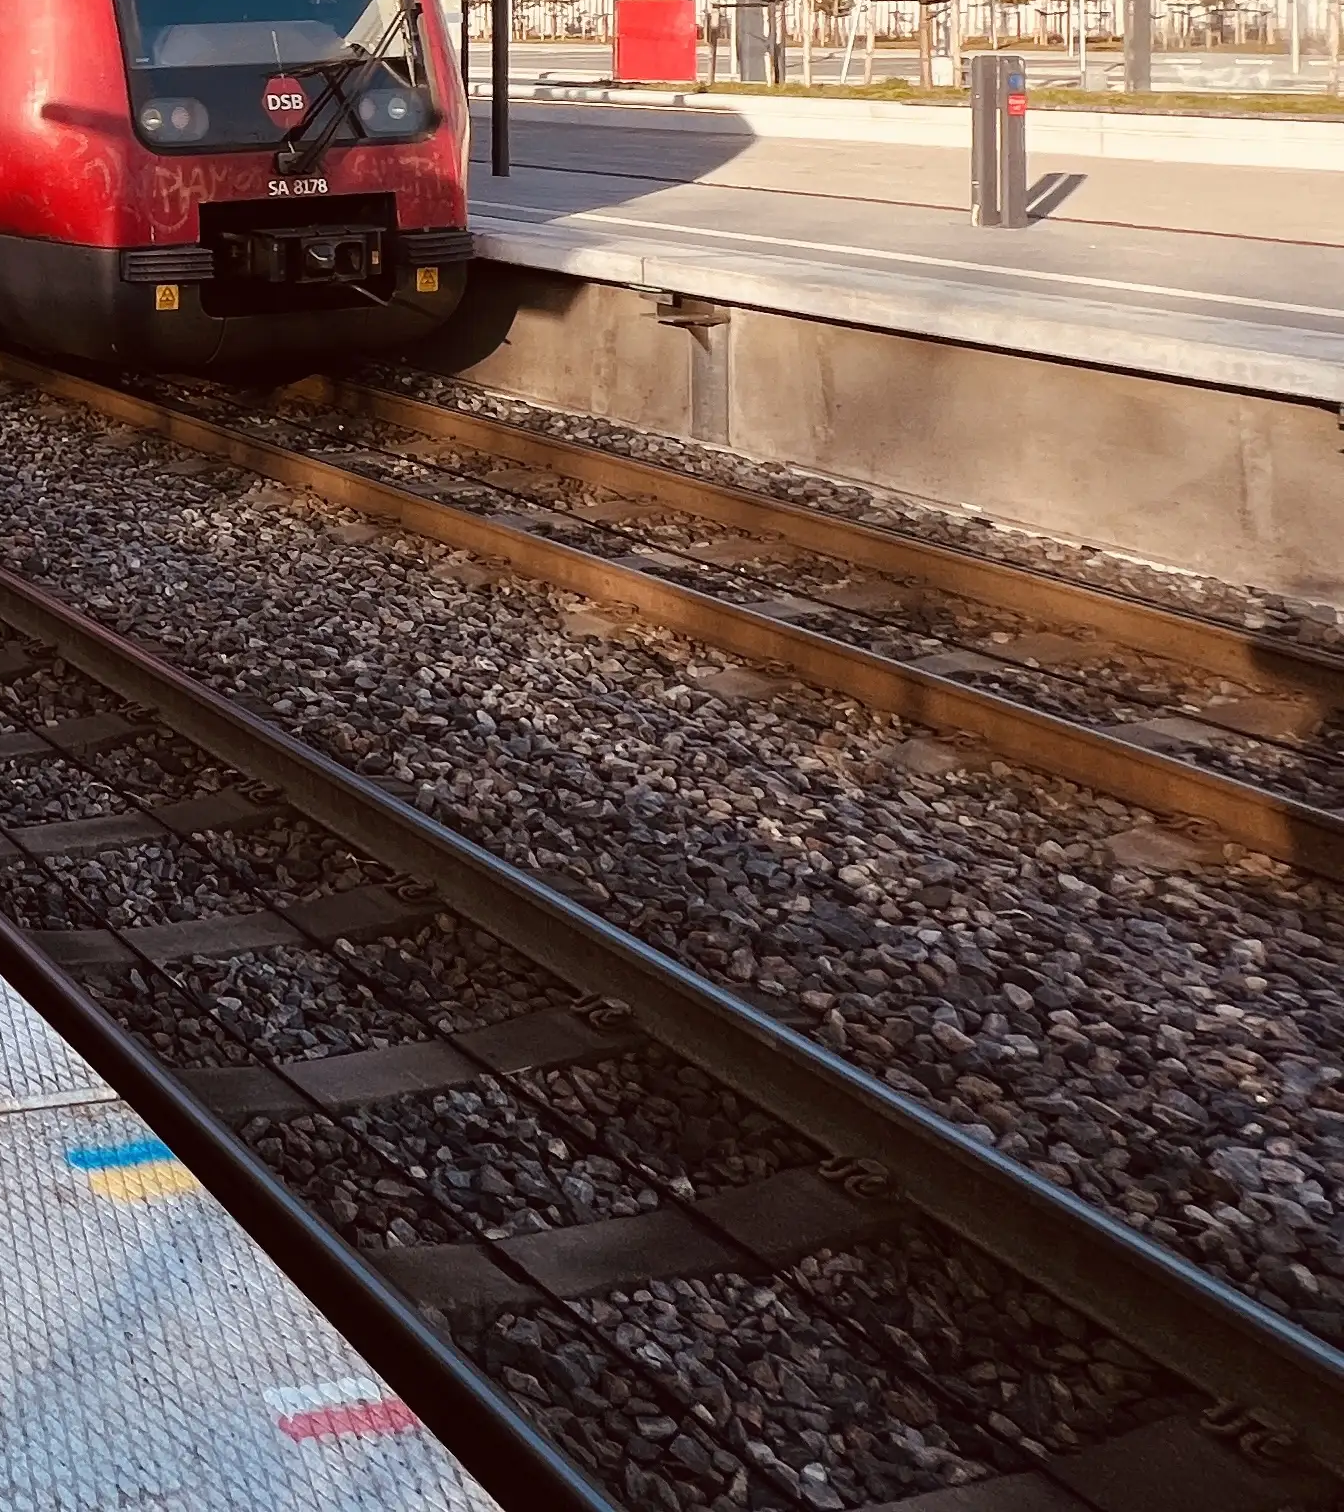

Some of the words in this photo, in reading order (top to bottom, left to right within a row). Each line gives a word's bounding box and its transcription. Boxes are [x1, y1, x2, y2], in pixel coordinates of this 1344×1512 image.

[266, 94, 304, 110] DSB
[268, 180, 290, 196] SA
[293, 178, 328, 195] 8178
